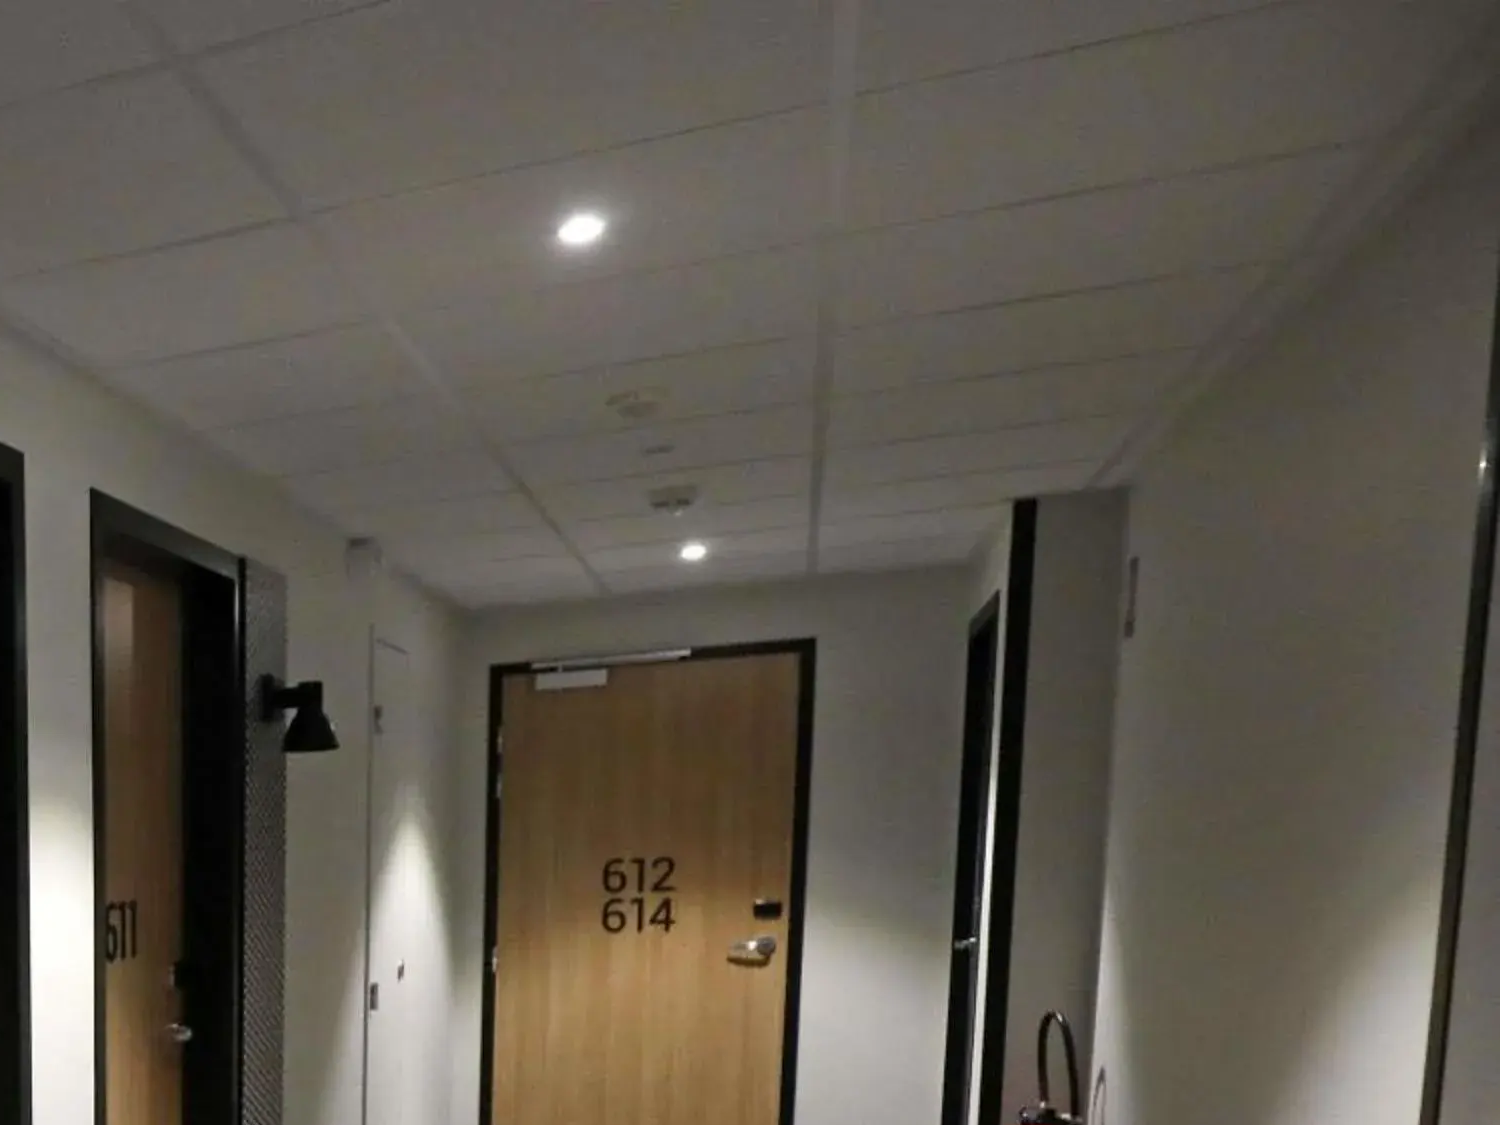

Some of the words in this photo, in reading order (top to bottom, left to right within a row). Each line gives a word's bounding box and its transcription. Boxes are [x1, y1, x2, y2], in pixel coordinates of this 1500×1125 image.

[601, 855, 677, 895] 612
[105, 899, 138, 963] 611
[601, 896, 675, 934] 614
